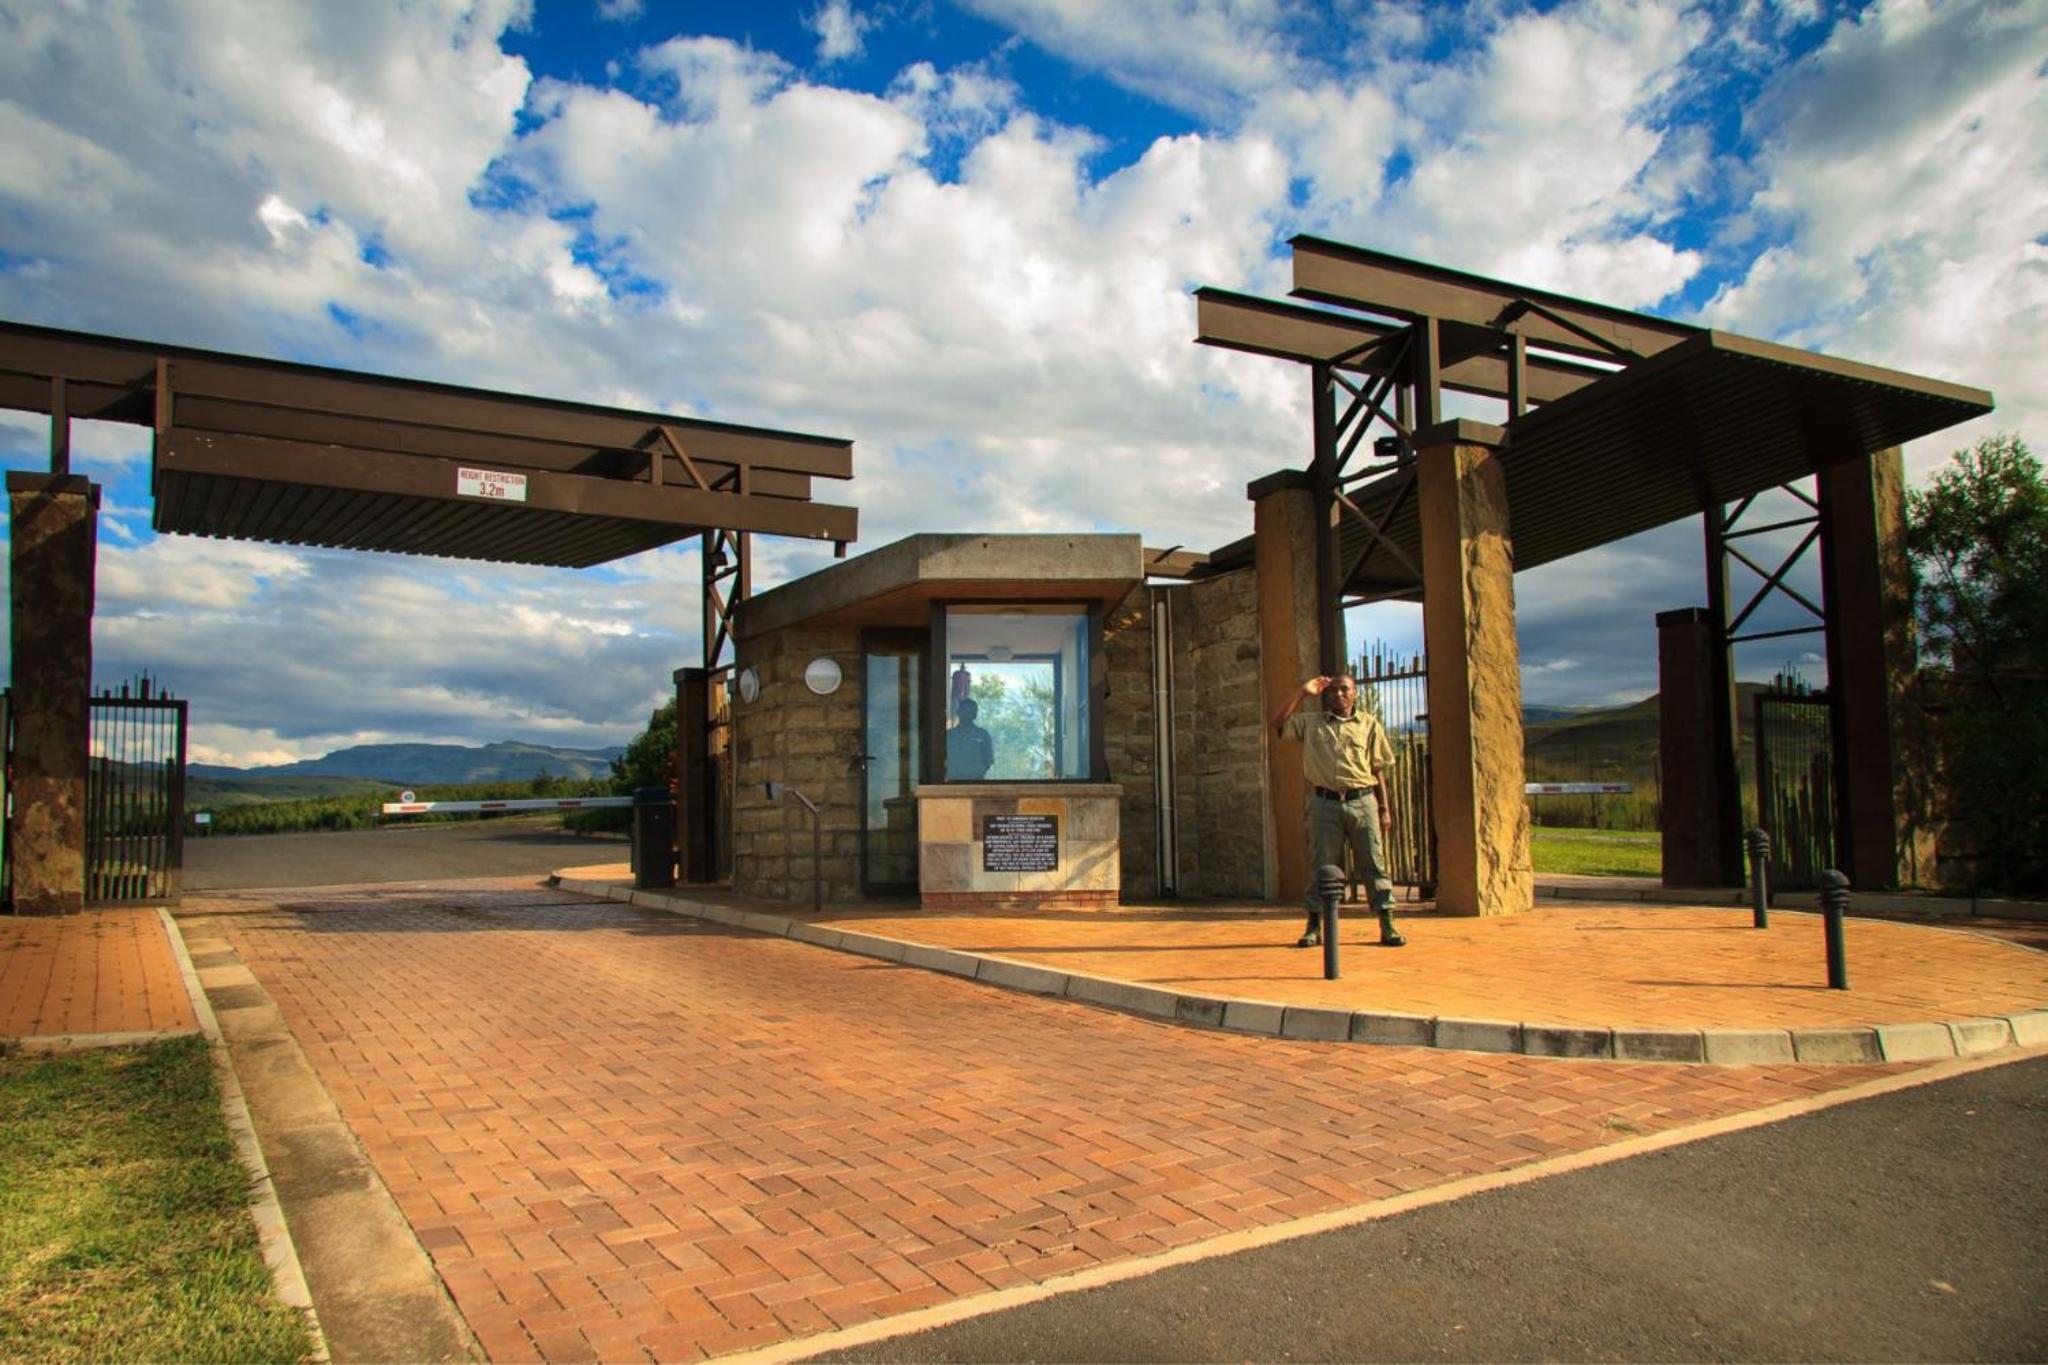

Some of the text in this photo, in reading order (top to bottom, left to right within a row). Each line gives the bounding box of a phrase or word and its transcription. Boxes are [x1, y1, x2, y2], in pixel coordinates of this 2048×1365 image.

[460, 470, 525, 485] HEIGHT RESTRICTION
[480, 482, 505, 497] 3.2m
